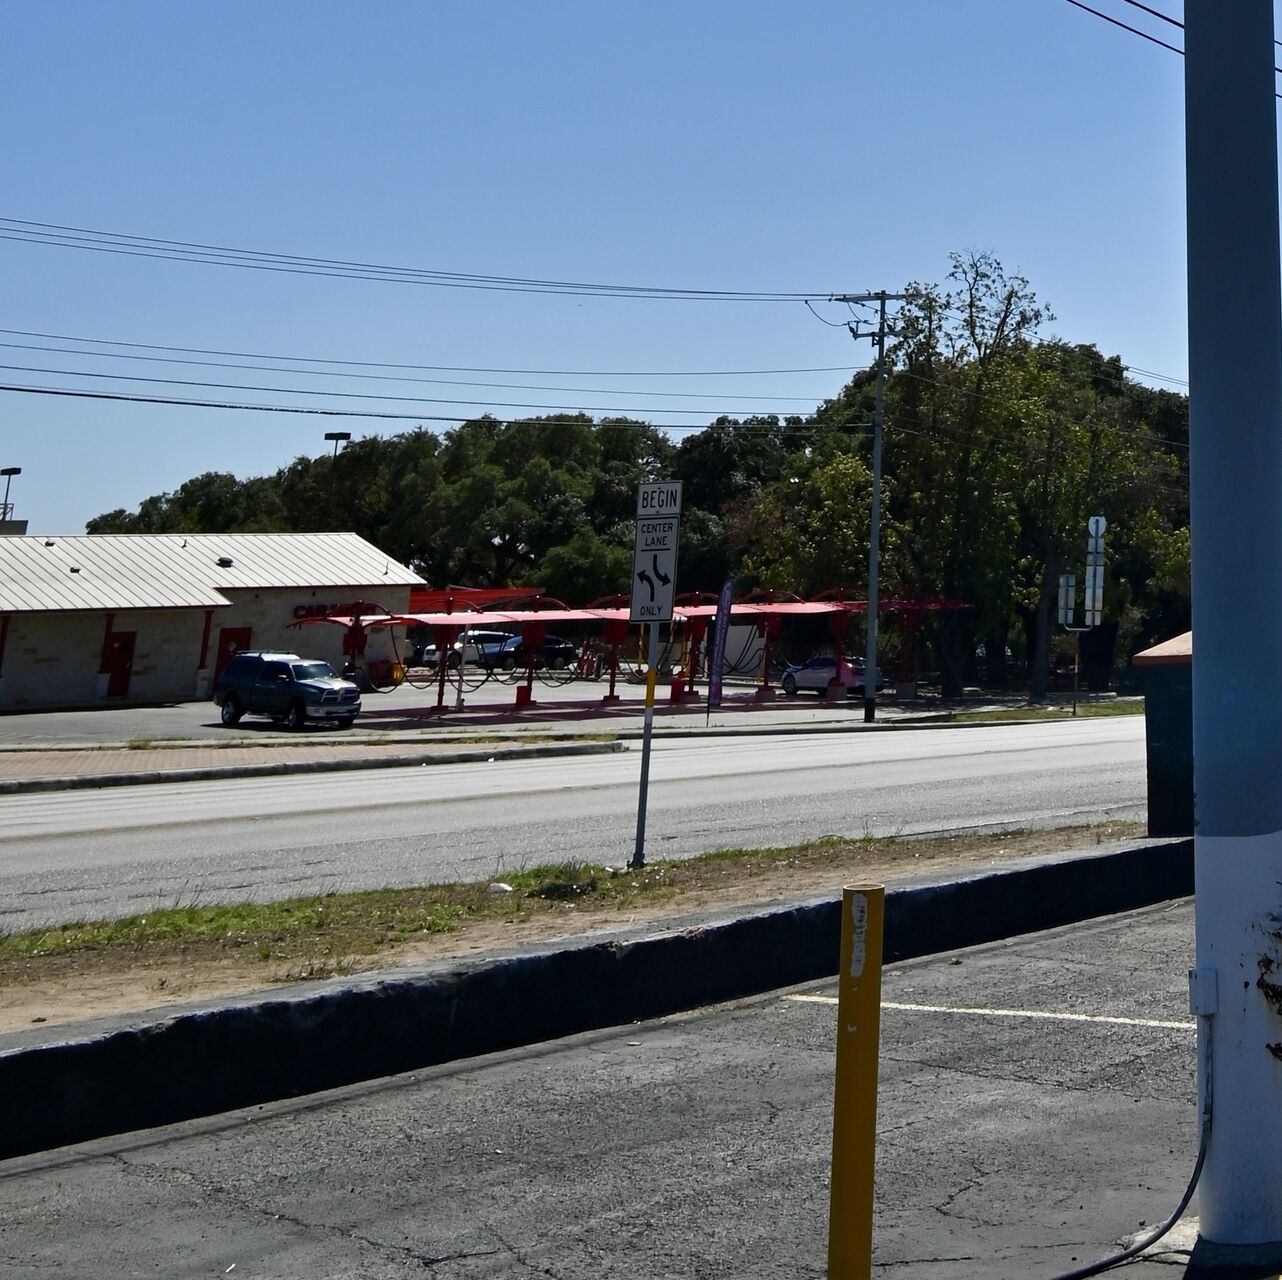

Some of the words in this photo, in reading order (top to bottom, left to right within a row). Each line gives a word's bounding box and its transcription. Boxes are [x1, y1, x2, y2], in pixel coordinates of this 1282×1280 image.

[641, 489, 678, 509] BEGIN
[641, 522, 673, 534] CENTER
[645, 536, 668, 547] LANE
[640, 606, 663, 616] ONLY
